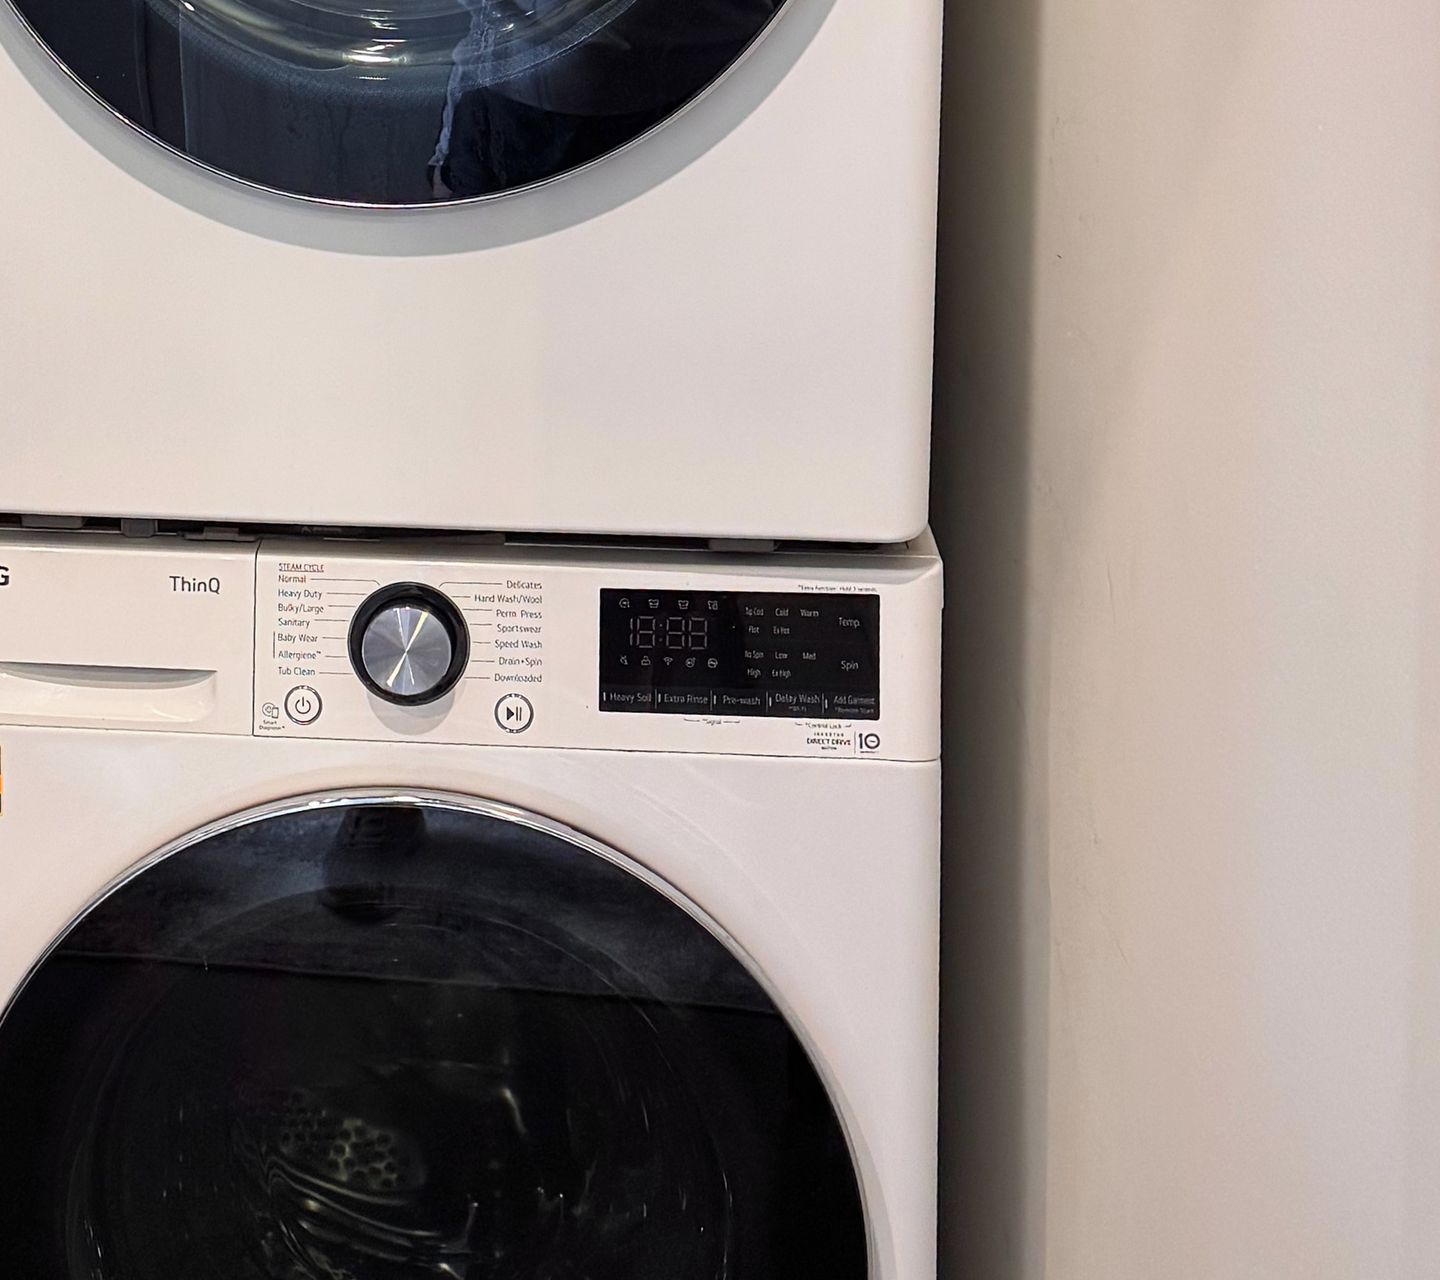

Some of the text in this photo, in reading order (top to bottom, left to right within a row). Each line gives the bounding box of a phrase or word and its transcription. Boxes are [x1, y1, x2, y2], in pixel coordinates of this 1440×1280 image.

[278, 562, 325, 573] STEAM CYCLE
[278, 574, 306, 584] Normal
[506, 579, 543, 589] Delicates
[169, 575, 220, 595] ThinQ
[278, 589, 323, 600] Heavy Duty
[474, 594, 543, 604] Hand Wash/Wool
[278, 603, 325, 615] Bulky/Large
[520, 609, 543, 619] Press
[775, 607, 789, 617] Cold
[800, 608, 819, 617] Warm
[278, 618, 310, 629] Sanitary
[496, 623, 542, 634] Sportswear
[278, 633, 318, 644] Baby Wear
[495, 639, 543, 650] Speed Wash
[278, 666, 316, 676] Tub Clean
[841, 660, 859, 671] Spin
[494, 673, 543, 683] Downloaded
[610, 692, 652, 703] Heavy Soil
[664, 693, 709, 705] Extra Rinse
[775, 693, 820, 705] Delay Wash
